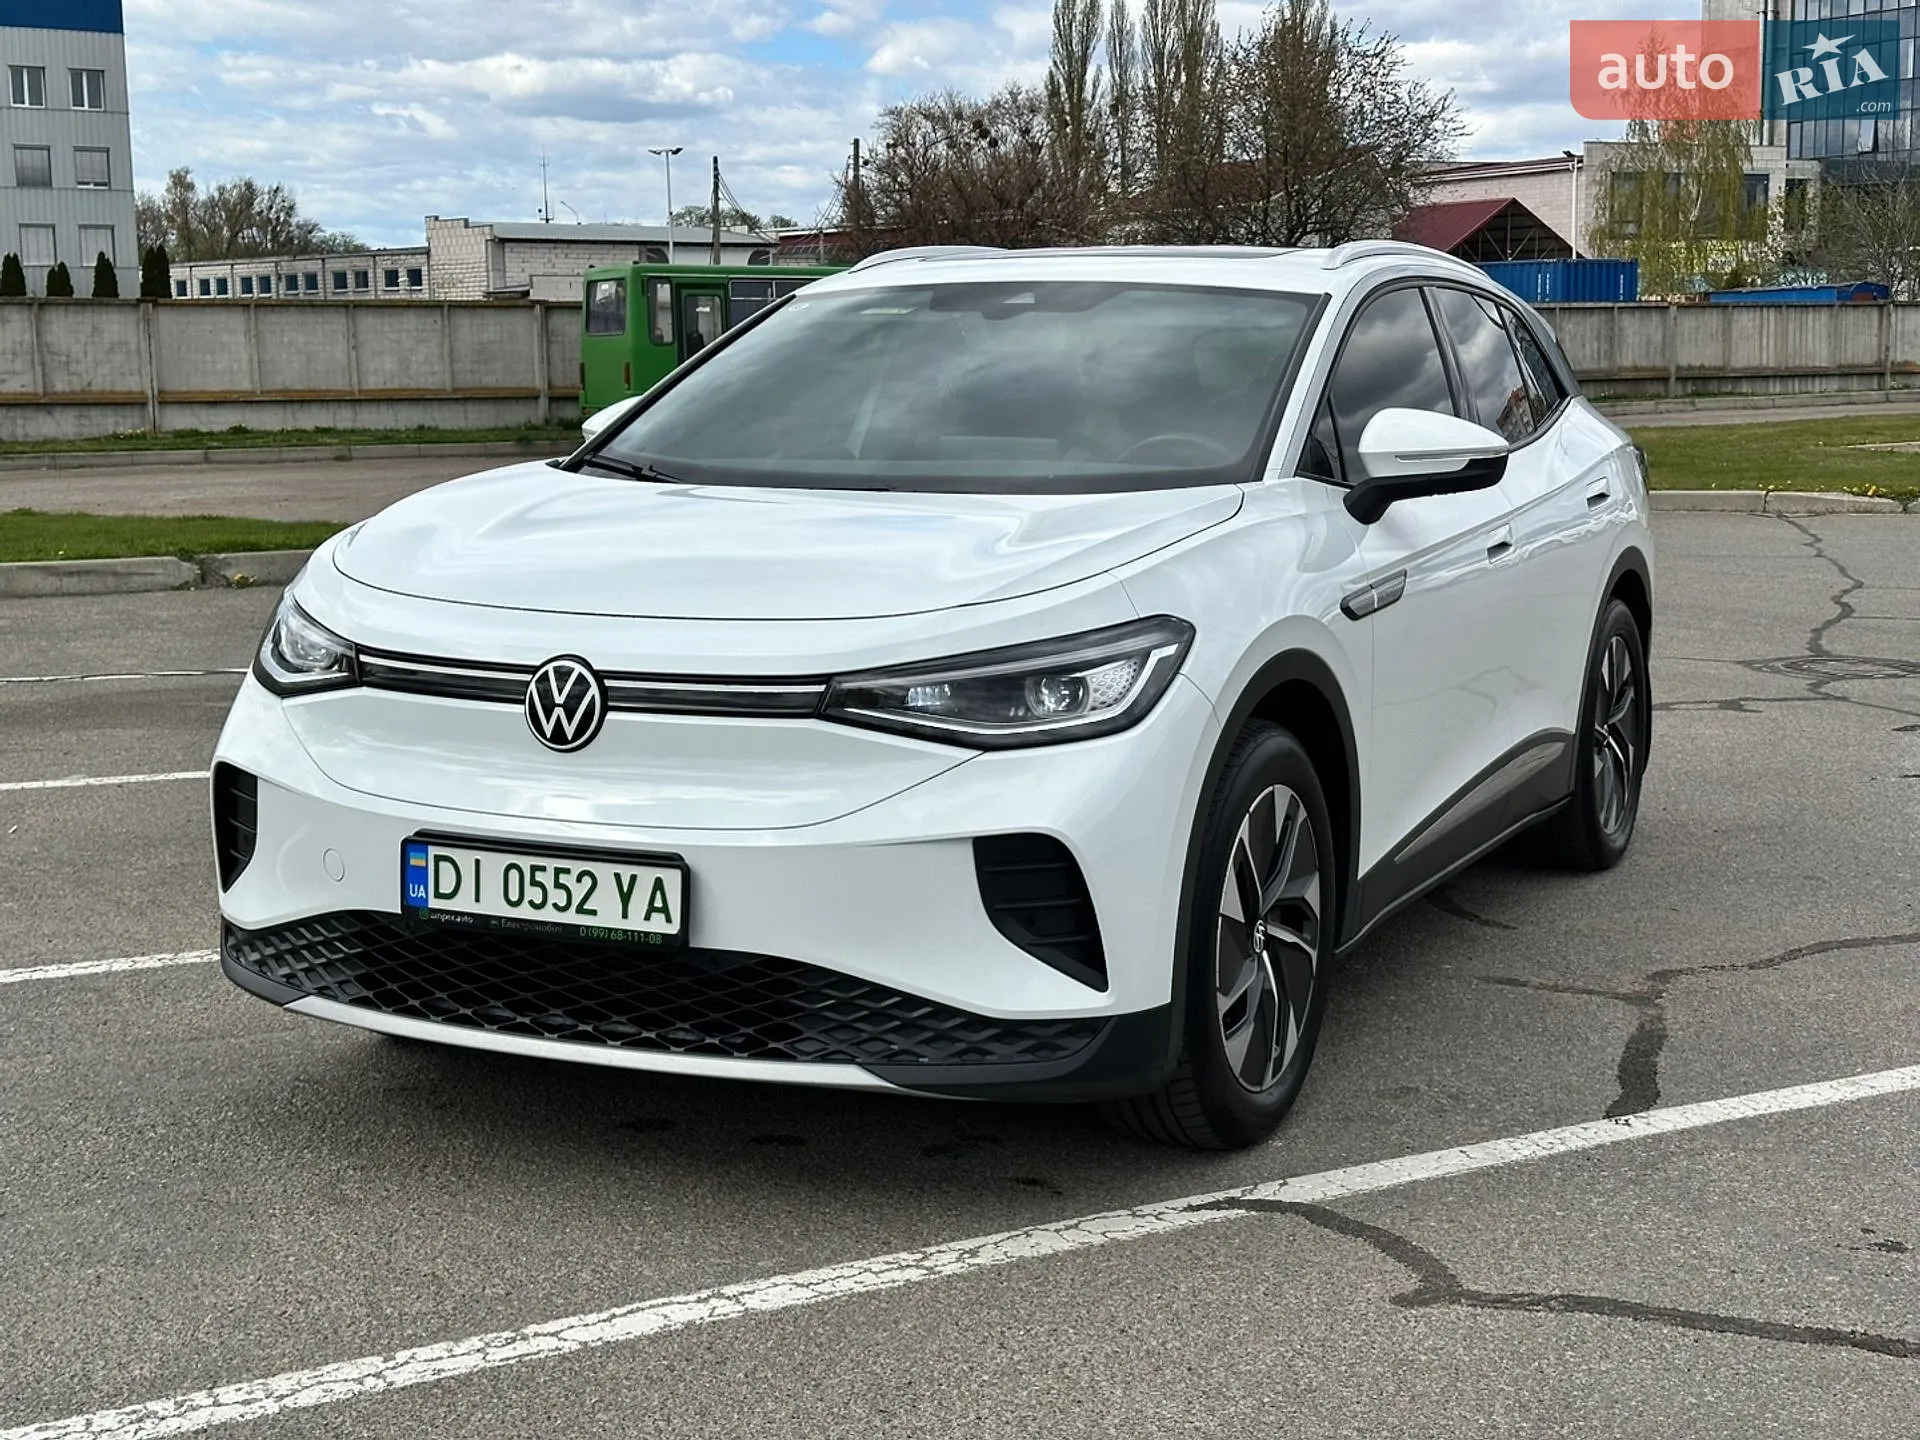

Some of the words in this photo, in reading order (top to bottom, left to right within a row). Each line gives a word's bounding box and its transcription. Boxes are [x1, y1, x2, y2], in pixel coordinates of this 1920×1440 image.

[409, 883, 427, 900] UA
[433, 854, 481, 903] DI
[502, 862, 599, 917] 0552
[613, 871, 673, 924] YA
[610, 930, 663, 945] 68-111-08
